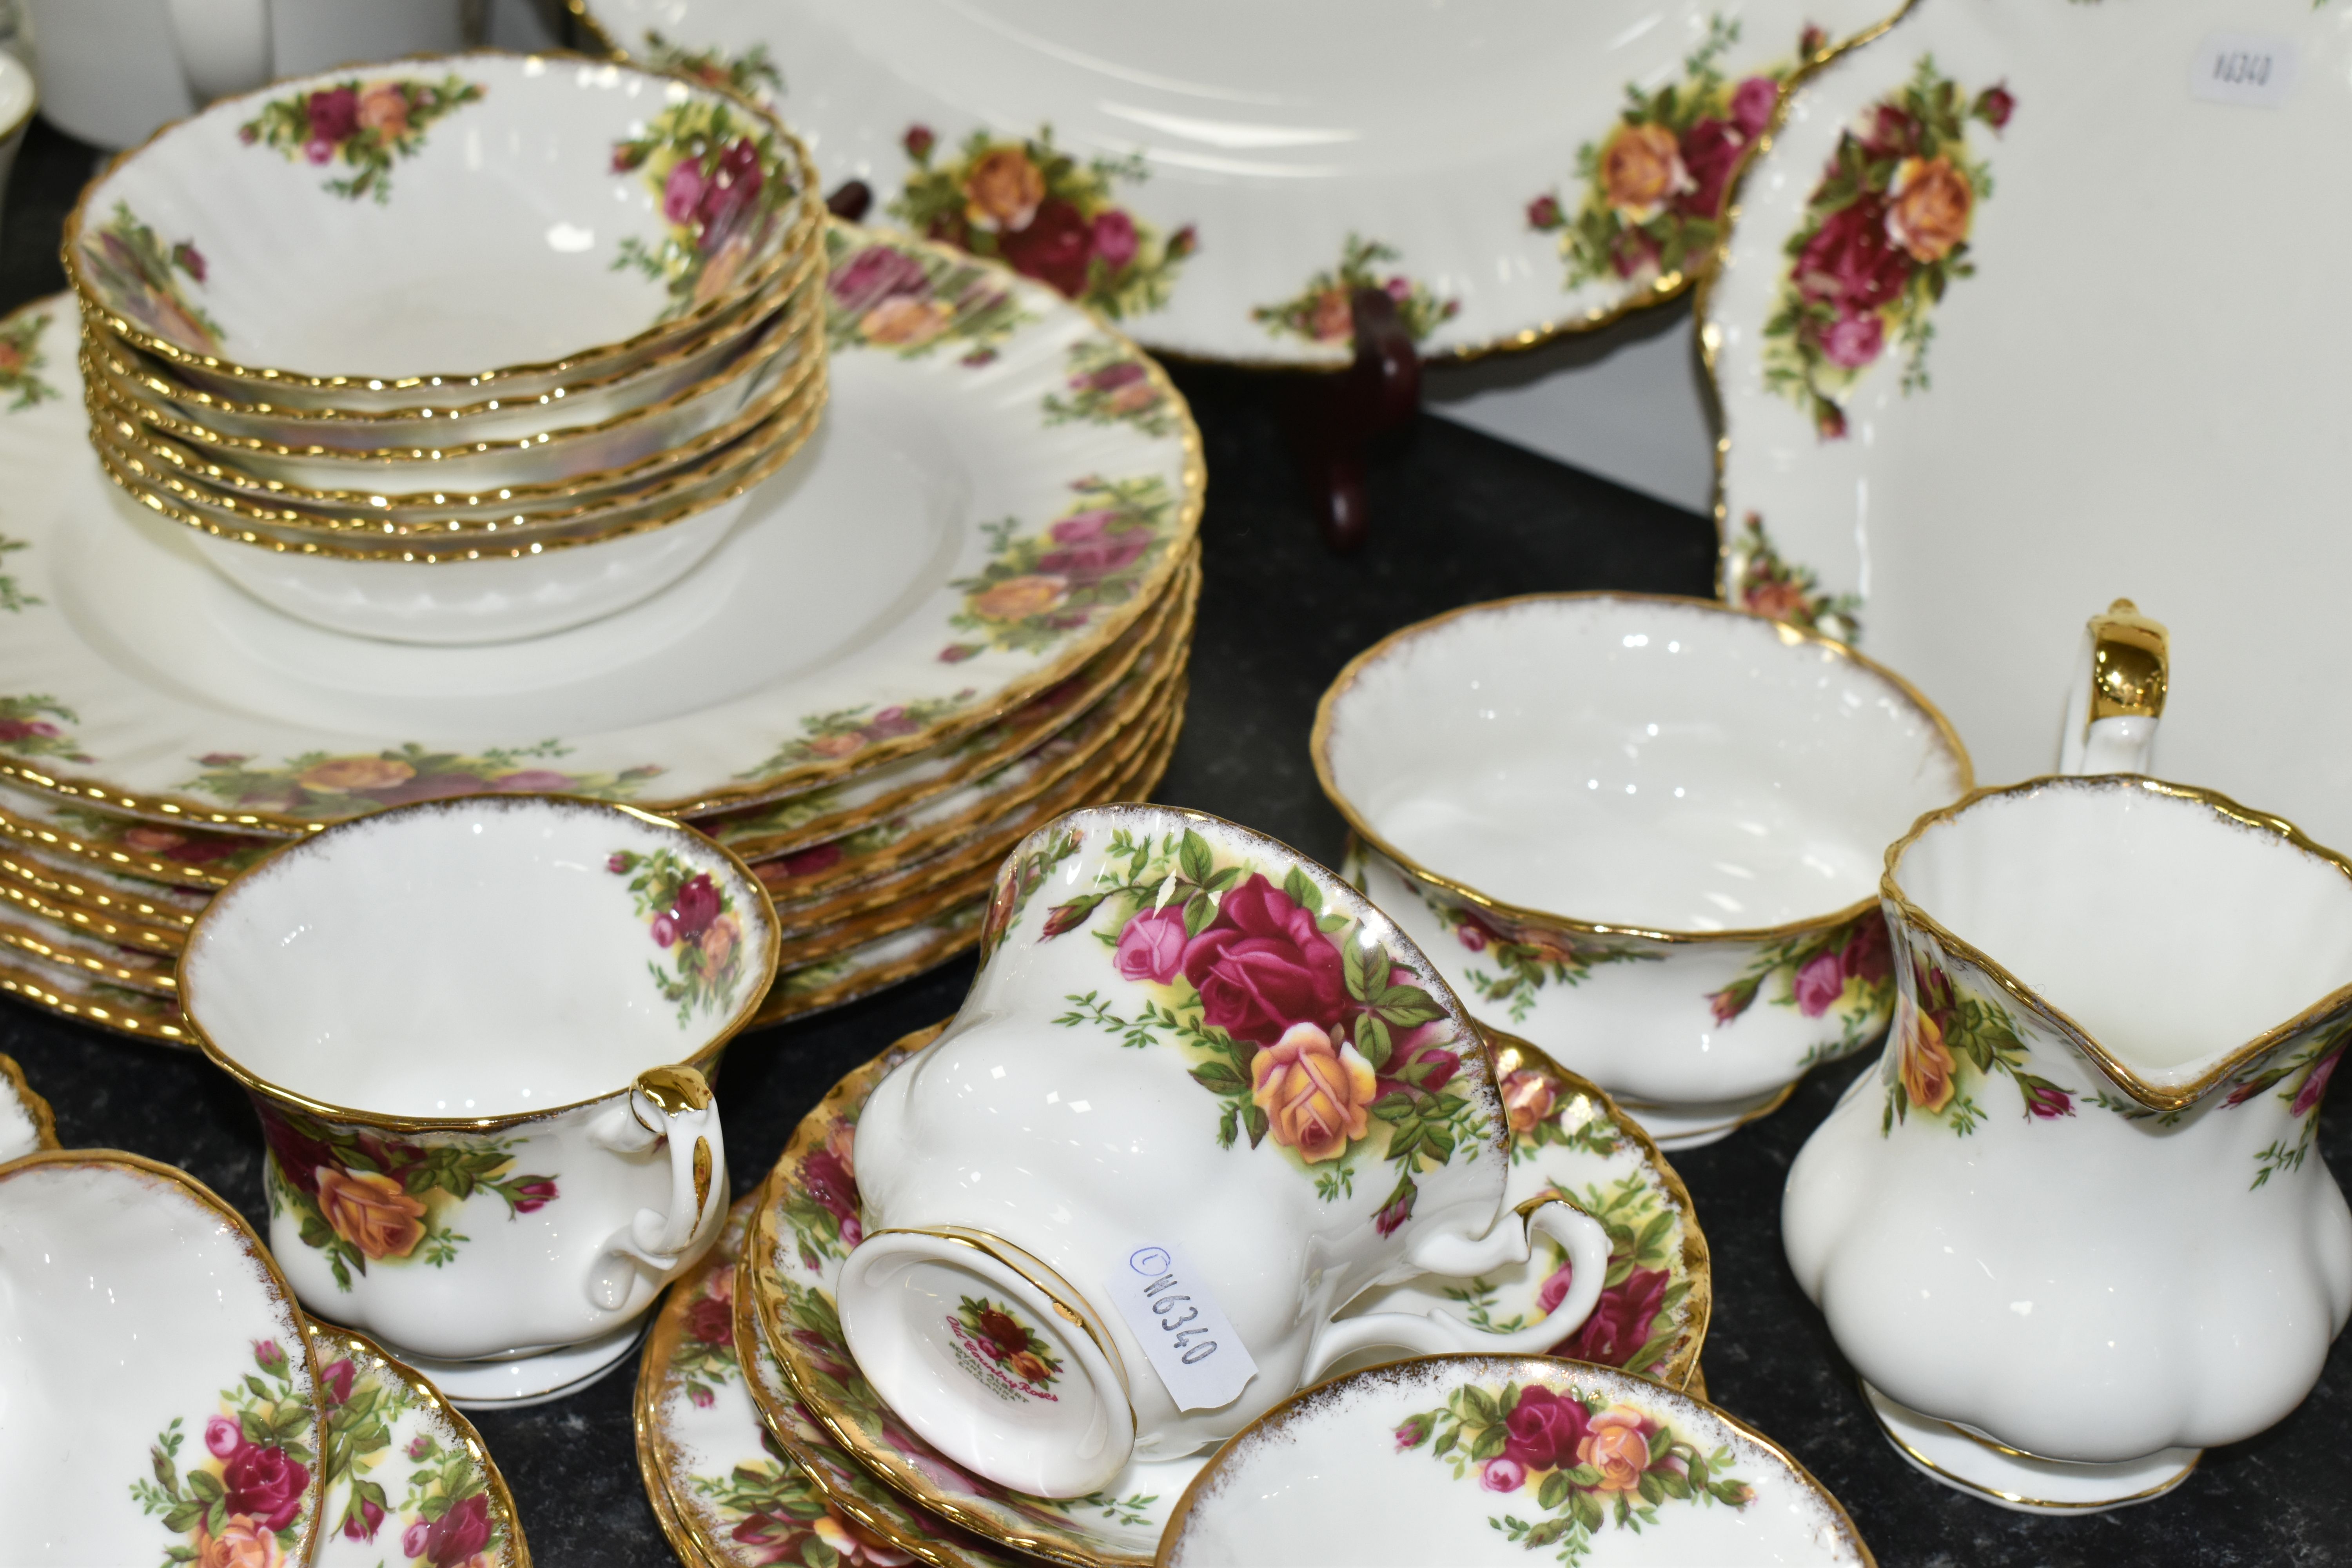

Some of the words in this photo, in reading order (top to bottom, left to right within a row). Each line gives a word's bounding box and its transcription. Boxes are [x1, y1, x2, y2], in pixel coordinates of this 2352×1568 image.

[946, 1316, 967, 1339] Old
[964, 1341, 1017, 1388] Country
[1018, 1381, 1058, 1402] Roses
[949, 1341, 982, 1371] ROYAL
[987, 1373, 1029, 1403] ALBERT
[955, 1352, 983, 1377] BONE
[987, 1378, 1016, 1401] CHINA
[958, 1361, 1008, 1401] ENGLAND
